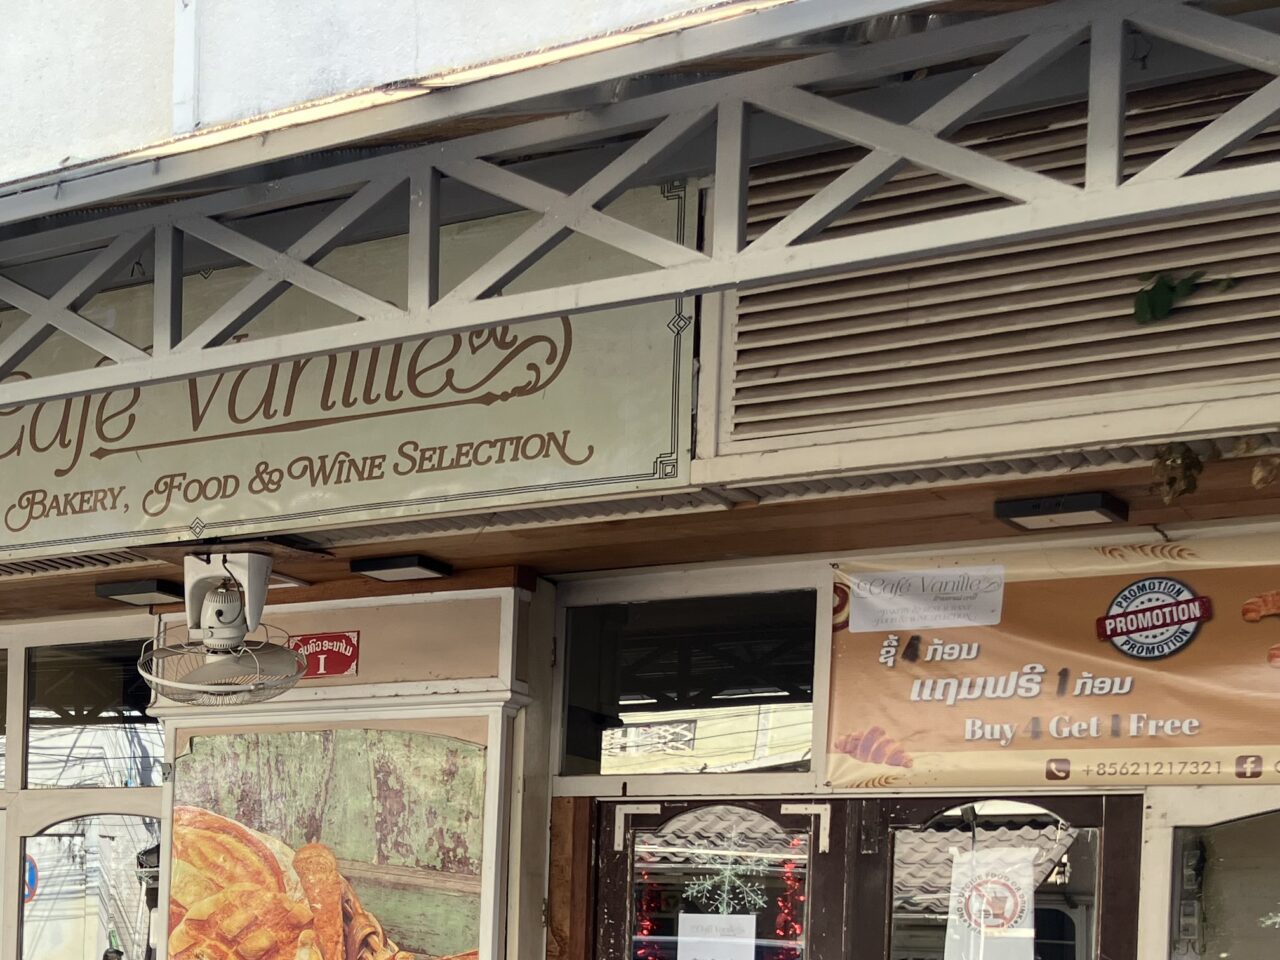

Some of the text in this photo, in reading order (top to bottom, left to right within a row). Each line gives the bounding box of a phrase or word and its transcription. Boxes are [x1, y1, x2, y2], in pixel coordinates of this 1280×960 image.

[248, 461, 284, 495] &
[1115, 581, 1185, 609] PROMOTION
[1105, 601, 1201, 635] PROMOTION
[1120, 628, 1191, 656] PROMOTION
[963, 718, 1016, 747] Buy
[1048, 714, 1102, 739] Get
[1128, 712, 1200, 737] Free
[1081, 760, 1221, 777] +85621217321
